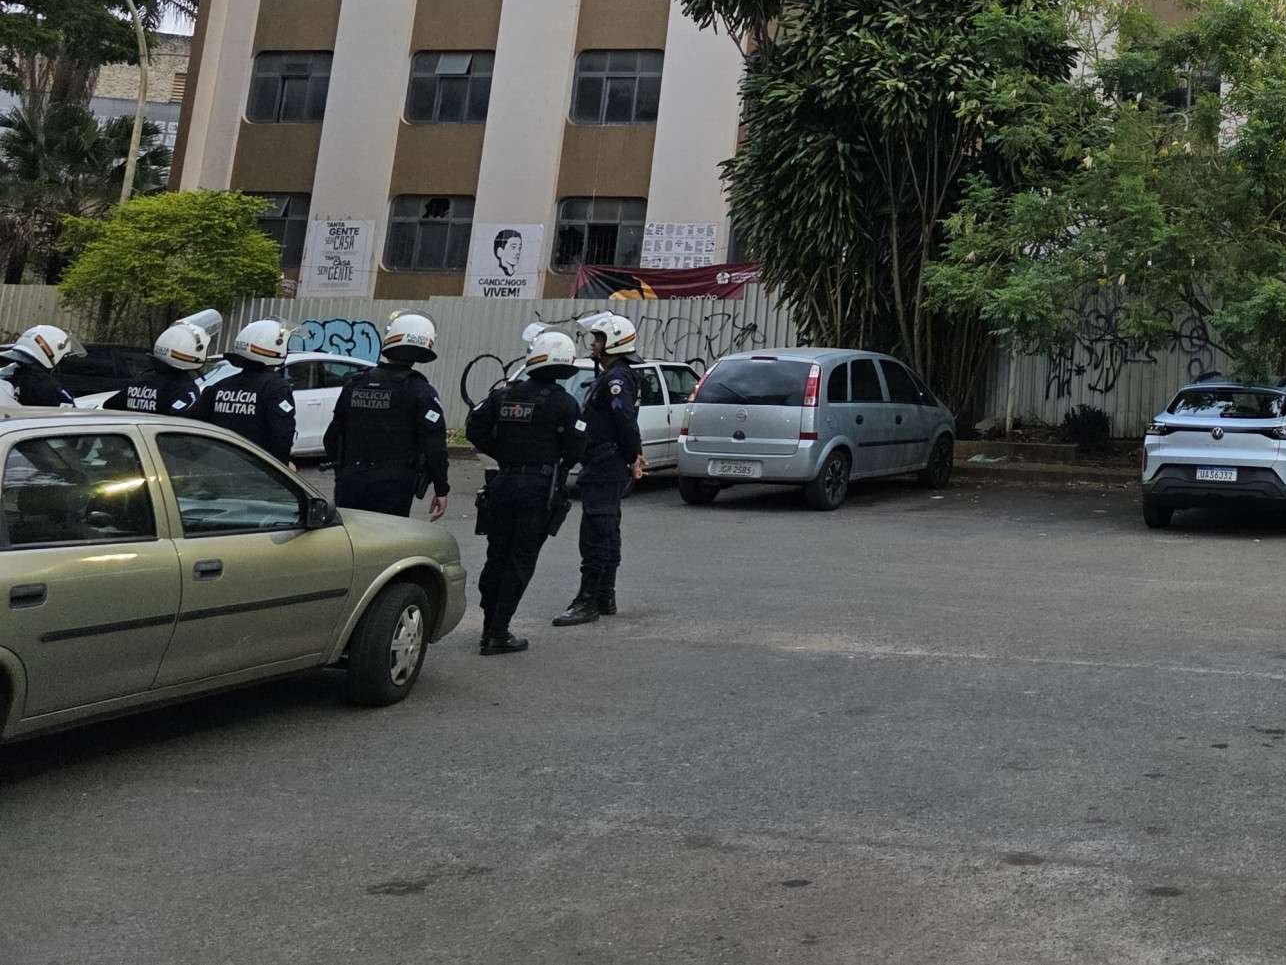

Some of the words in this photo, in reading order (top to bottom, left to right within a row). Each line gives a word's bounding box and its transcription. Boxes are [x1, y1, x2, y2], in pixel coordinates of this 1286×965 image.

[329, 228, 360, 236] GENTE
[333, 236, 355, 250] CASA
[328, 266, 354, 281] GENTE
[484, 288, 520, 297] VIVEM!
[127, 386, 157, 398] POLÍCIA
[216, 389, 257, 403] POLÍCIA
[126, 398, 156, 411] MILITAR
[214, 402, 256, 415] MILITAR
[351, 399, 390, 409] MILITAR
[501, 405, 532, 418] GTOP
